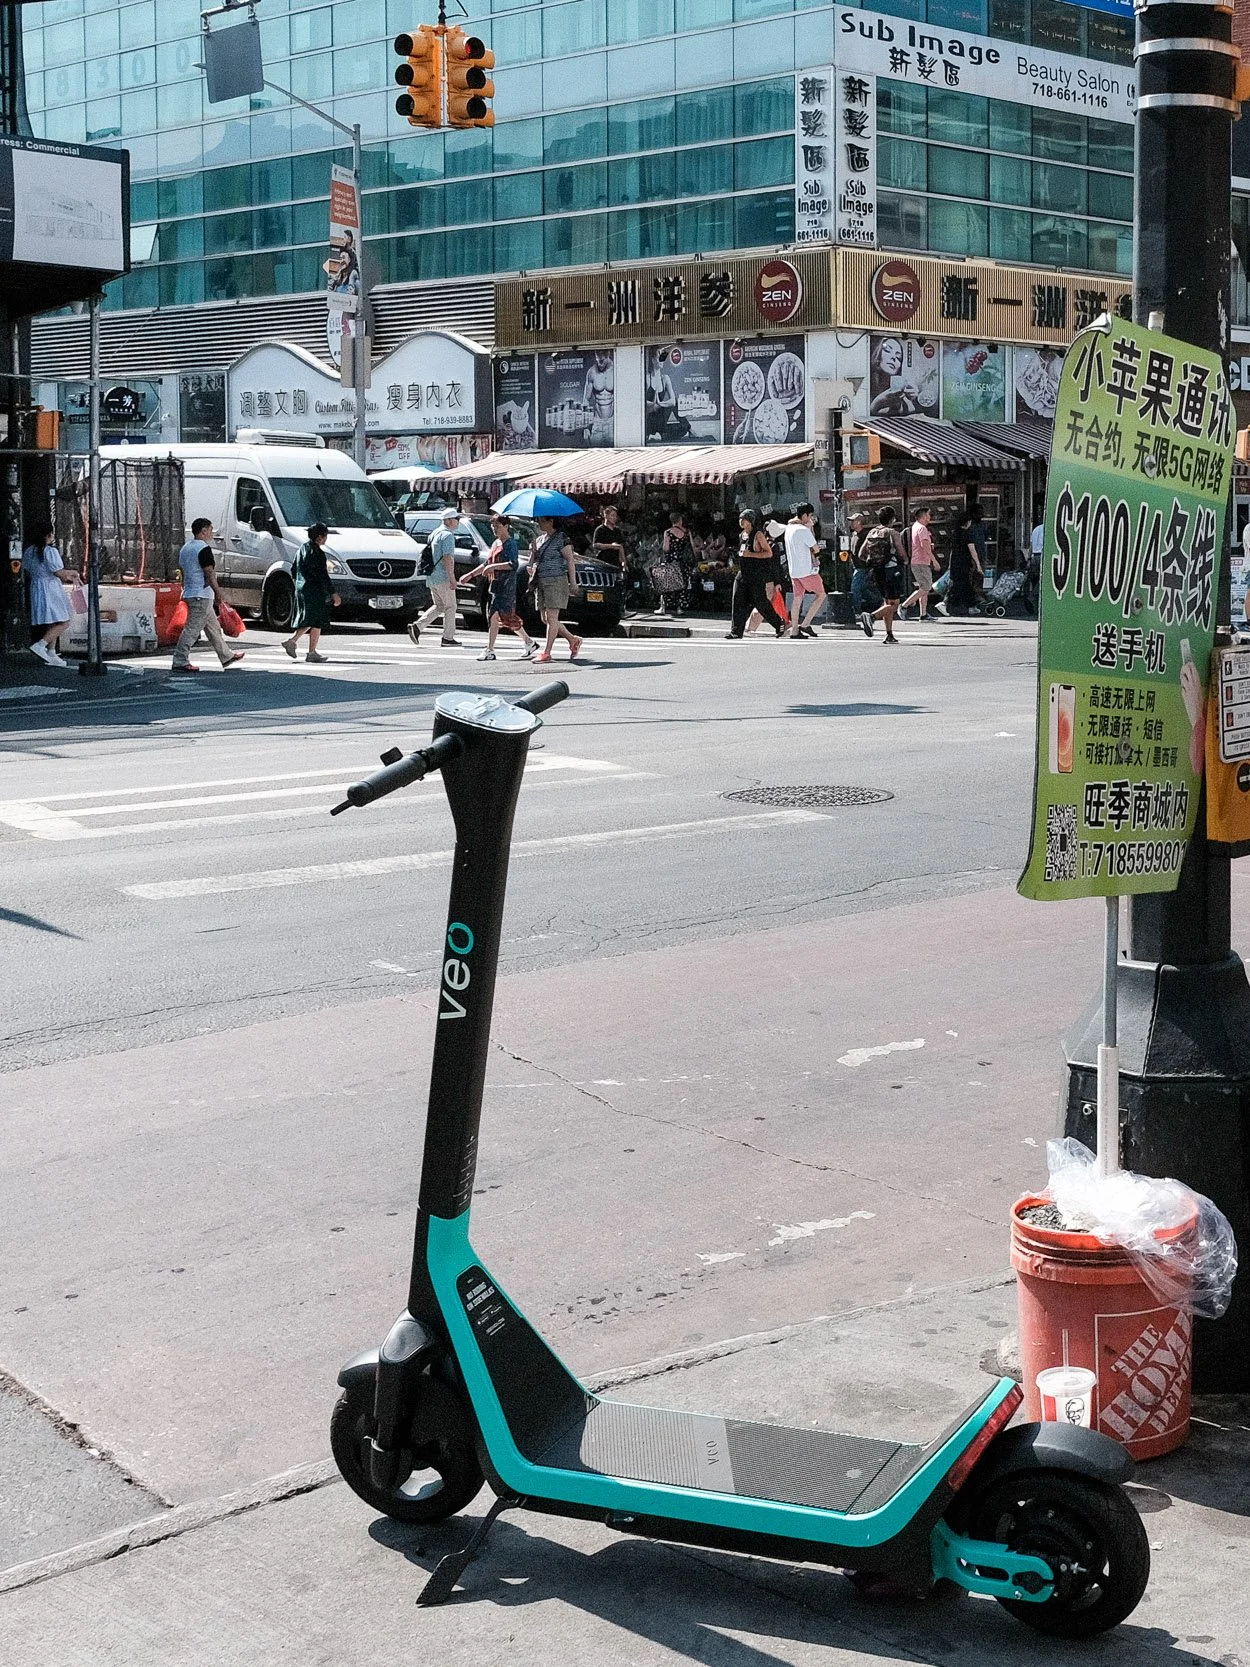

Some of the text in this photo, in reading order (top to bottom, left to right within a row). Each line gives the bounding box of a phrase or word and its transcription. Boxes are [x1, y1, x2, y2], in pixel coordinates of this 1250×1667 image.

[841, 12, 1001, 66] Sub Image
[889, 47, 961, 86] 新髮區
[1017, 56, 1072, 88] Beauty
[1077, 69, 1119, 95] Salon
[1032, 82, 1108, 109] 718-661-1116
[800, 77, 827, 172] 新髮區
[843, 76, 872, 173] 新髮區
[26, 141, 80, 156] Commercial
[803, 180, 820, 195] Sub
[849, 180, 867, 196] Sub
[798, 198, 828, 215] Image
[842, 195, 874, 215] Image
[797, 228, 829, 241] 661-1116
[841, 228, 875, 242] 661-1116
[762, 289, 792, 302] ZEN
[882, 289, 914, 303] ZEN
[387, 380, 462, 411] 瘦身内衣
[966, 382, 997, 392] GINSENG
[1091, 623, 1167, 674] 送手机
[1089, 684, 1156, 712] 高速无限上网
[1083, 779, 1189, 832] 旺季商城内
[440, 921, 475, 1020] veo
[1110, 1323, 1163, 1379] THE
